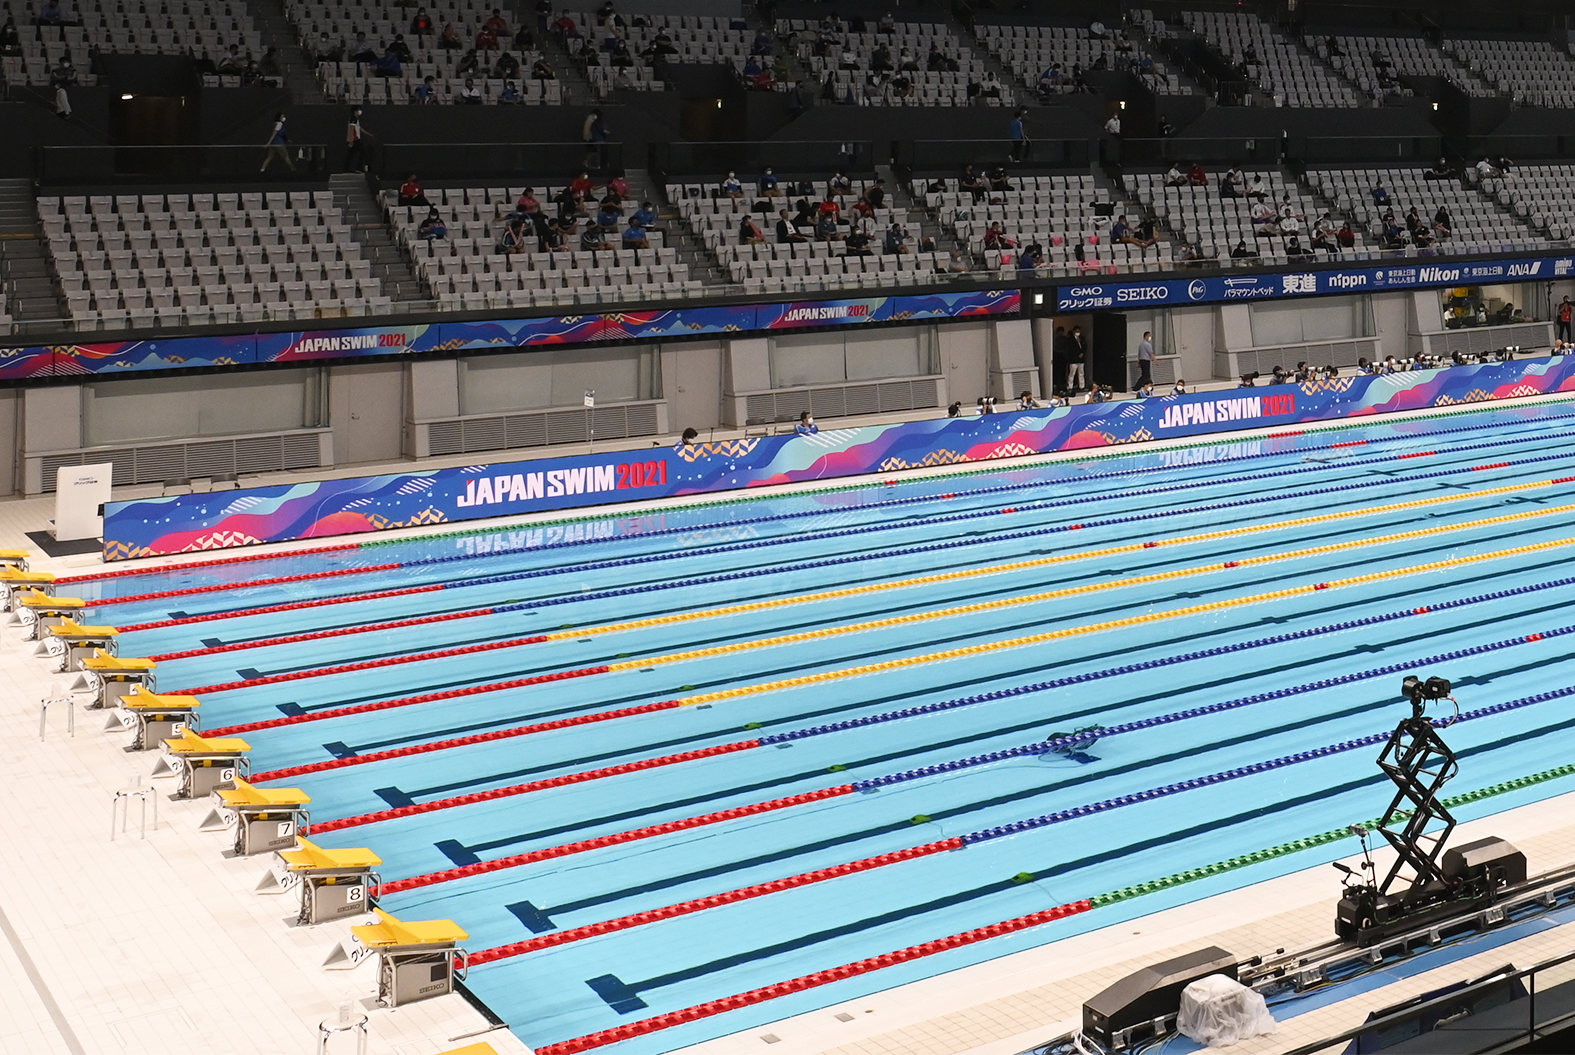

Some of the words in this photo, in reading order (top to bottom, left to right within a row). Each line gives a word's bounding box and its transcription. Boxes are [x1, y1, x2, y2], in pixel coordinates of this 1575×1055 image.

[1419, 267, 1460, 283] Nikon
[1506, 263, 1530, 277] ANA
[1282, 273, 1317, 294] 東進
[1328, 273, 1367, 289] nippn
[1070, 287, 1102, 297] GMO
[1117, 286, 1168, 302] SEIKO
[1224, 286, 1274, 298] パラマウントベッド
[1060, 297, 1112, 309] クリック証券
[784, 308, 819, 322] JAPAN
[820, 306, 848, 319] SWIM
[848, 305, 869, 317] 2021
[294, 337, 340, 353] JAPAN
[342, 335, 378, 351] SWIM
[378, 333, 406, 347] 2021
[1158, 401, 1216, 429] JAPAN
[1216, 397, 1262, 422] SWIM
[1262, 393, 1296, 417] 2021
[456, 472, 544, 508] JAPAN
[546, 465, 615, 497] SWIM
[616, 459, 668, 490] 2021
[223, 769, 232, 781] 6
[281, 823, 291, 835] 7
[350, 887, 361, 901] 8
[336, 904, 360, 913] SEIKO
[419, 983, 444, 994] SEIKO
